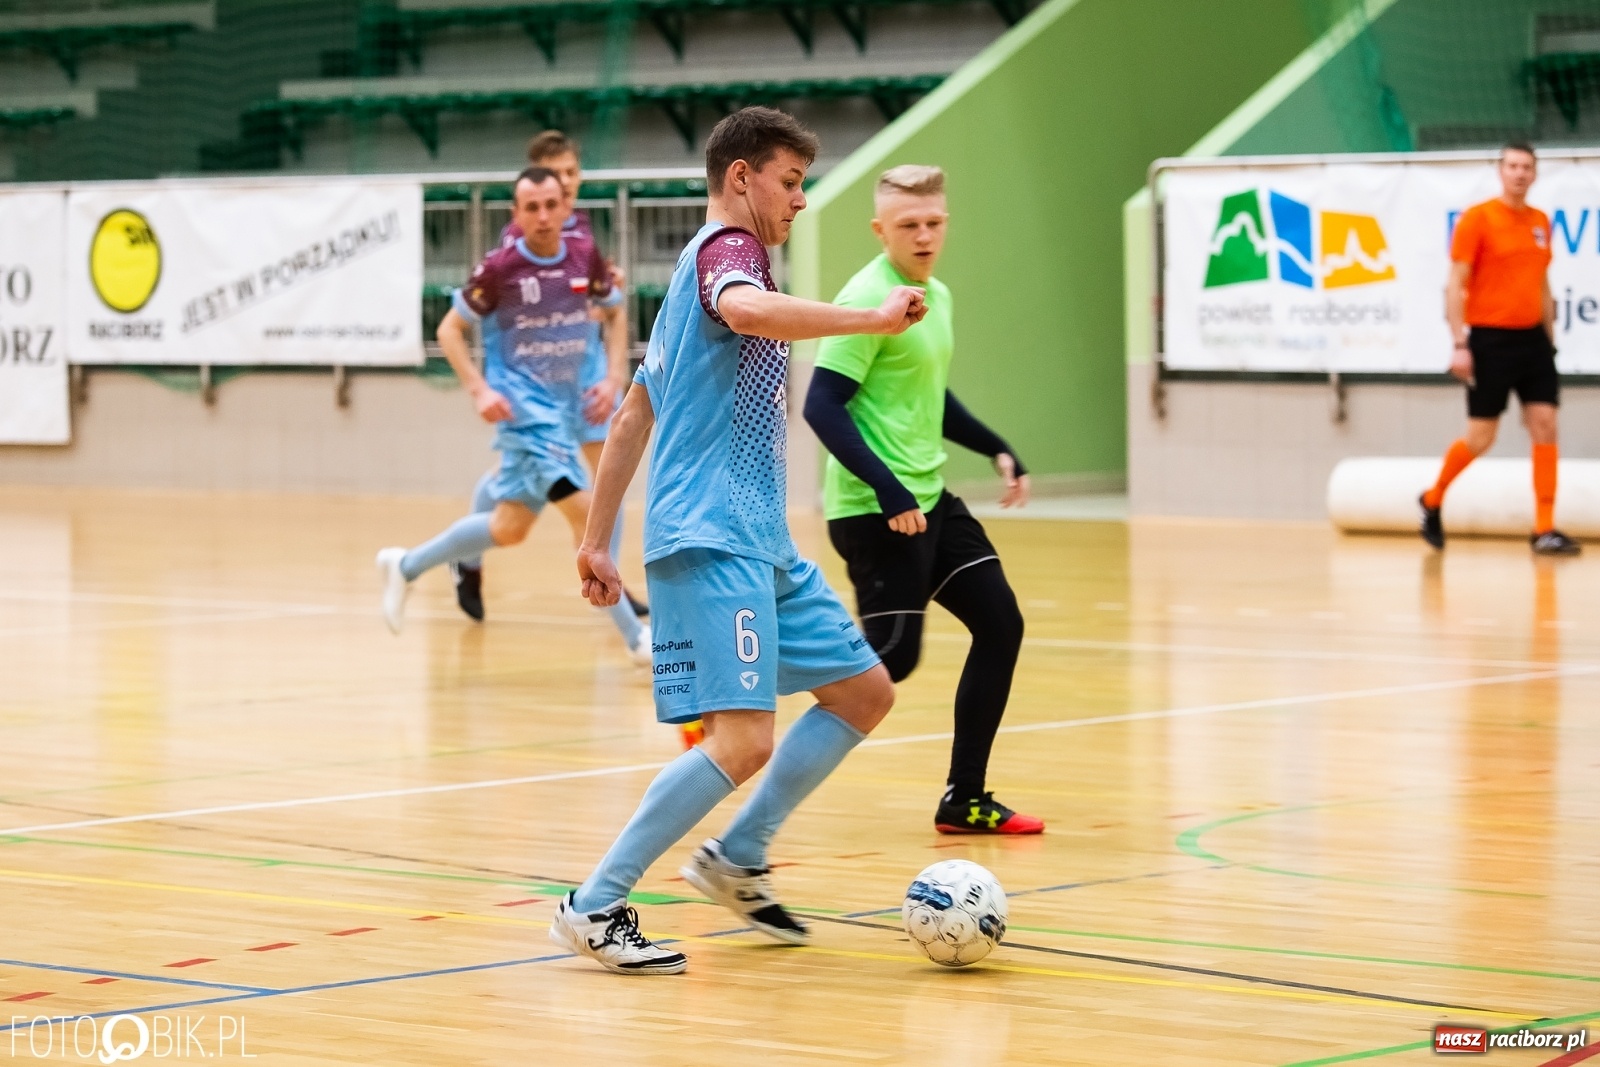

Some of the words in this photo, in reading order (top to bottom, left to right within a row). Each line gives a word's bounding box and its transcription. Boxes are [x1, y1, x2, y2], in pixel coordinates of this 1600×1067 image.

[180, 286, 230, 335] JEST
[234, 272, 256, 303] W
[519, 277, 541, 304] 10
[734, 607, 760, 664] 6
[658, 683, 691, 696] KIETRZ
